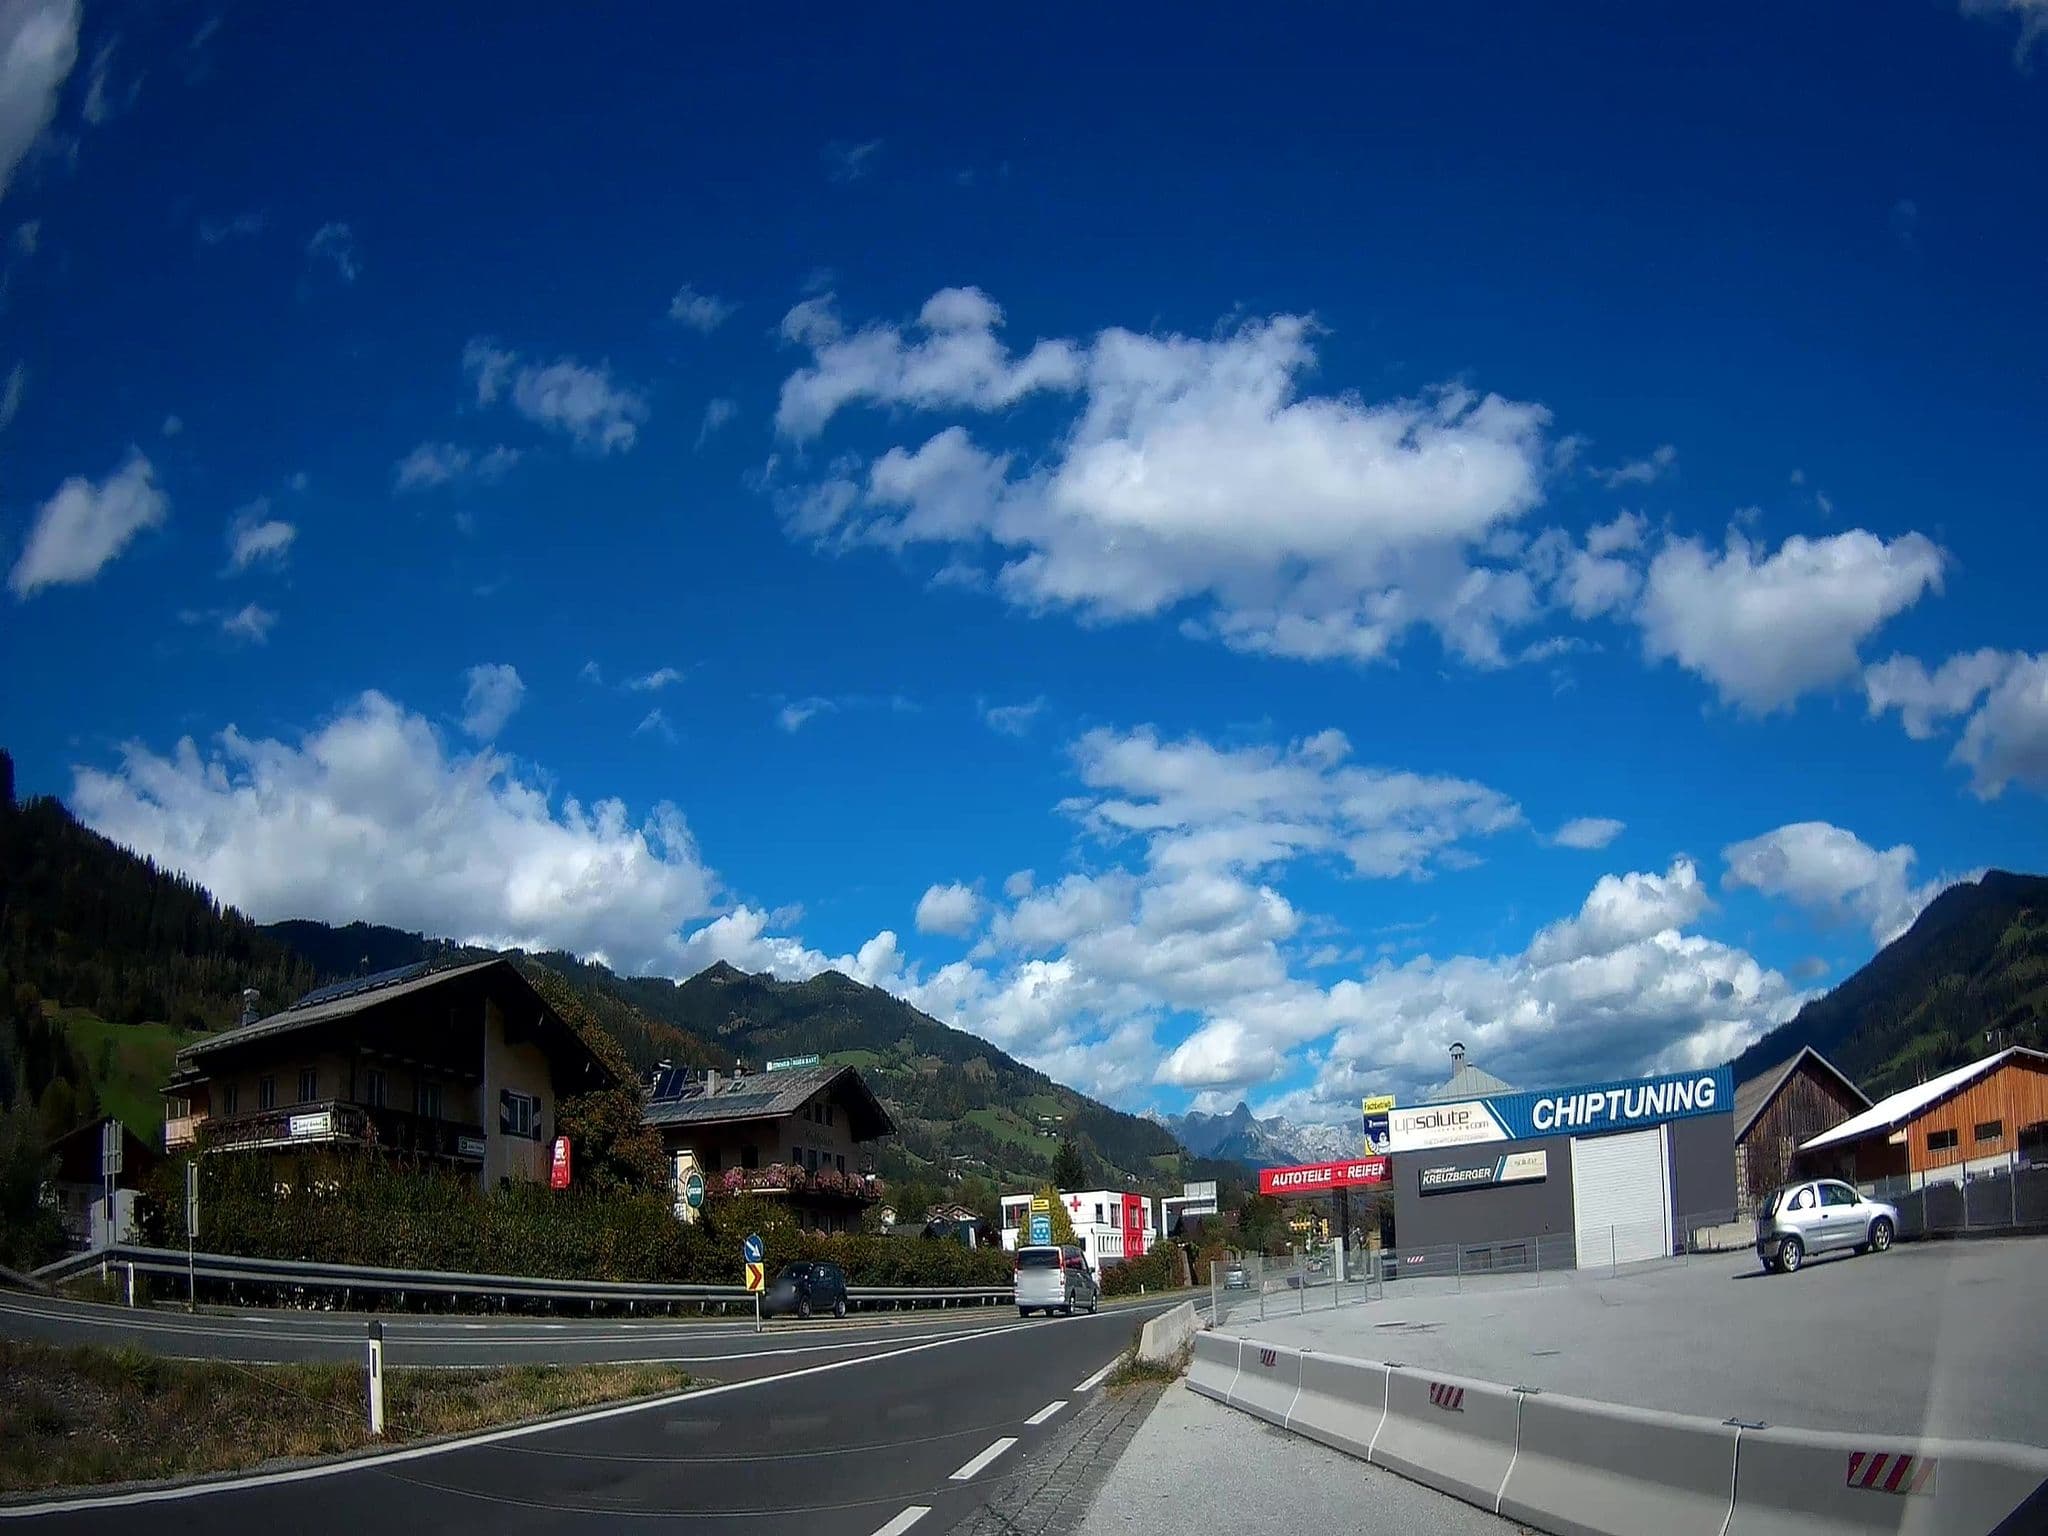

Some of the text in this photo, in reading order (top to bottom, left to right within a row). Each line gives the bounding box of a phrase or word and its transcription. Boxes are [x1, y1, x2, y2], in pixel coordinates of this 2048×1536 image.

[1532, 1077, 1715, 1130] CHIPTUNING
[1394, 1110, 1469, 1134] upsolute
[1272, 1162, 1385, 1187] AUTOTEILE REIFEN
[1422, 1167, 1491, 1185] KREUZBERGER
